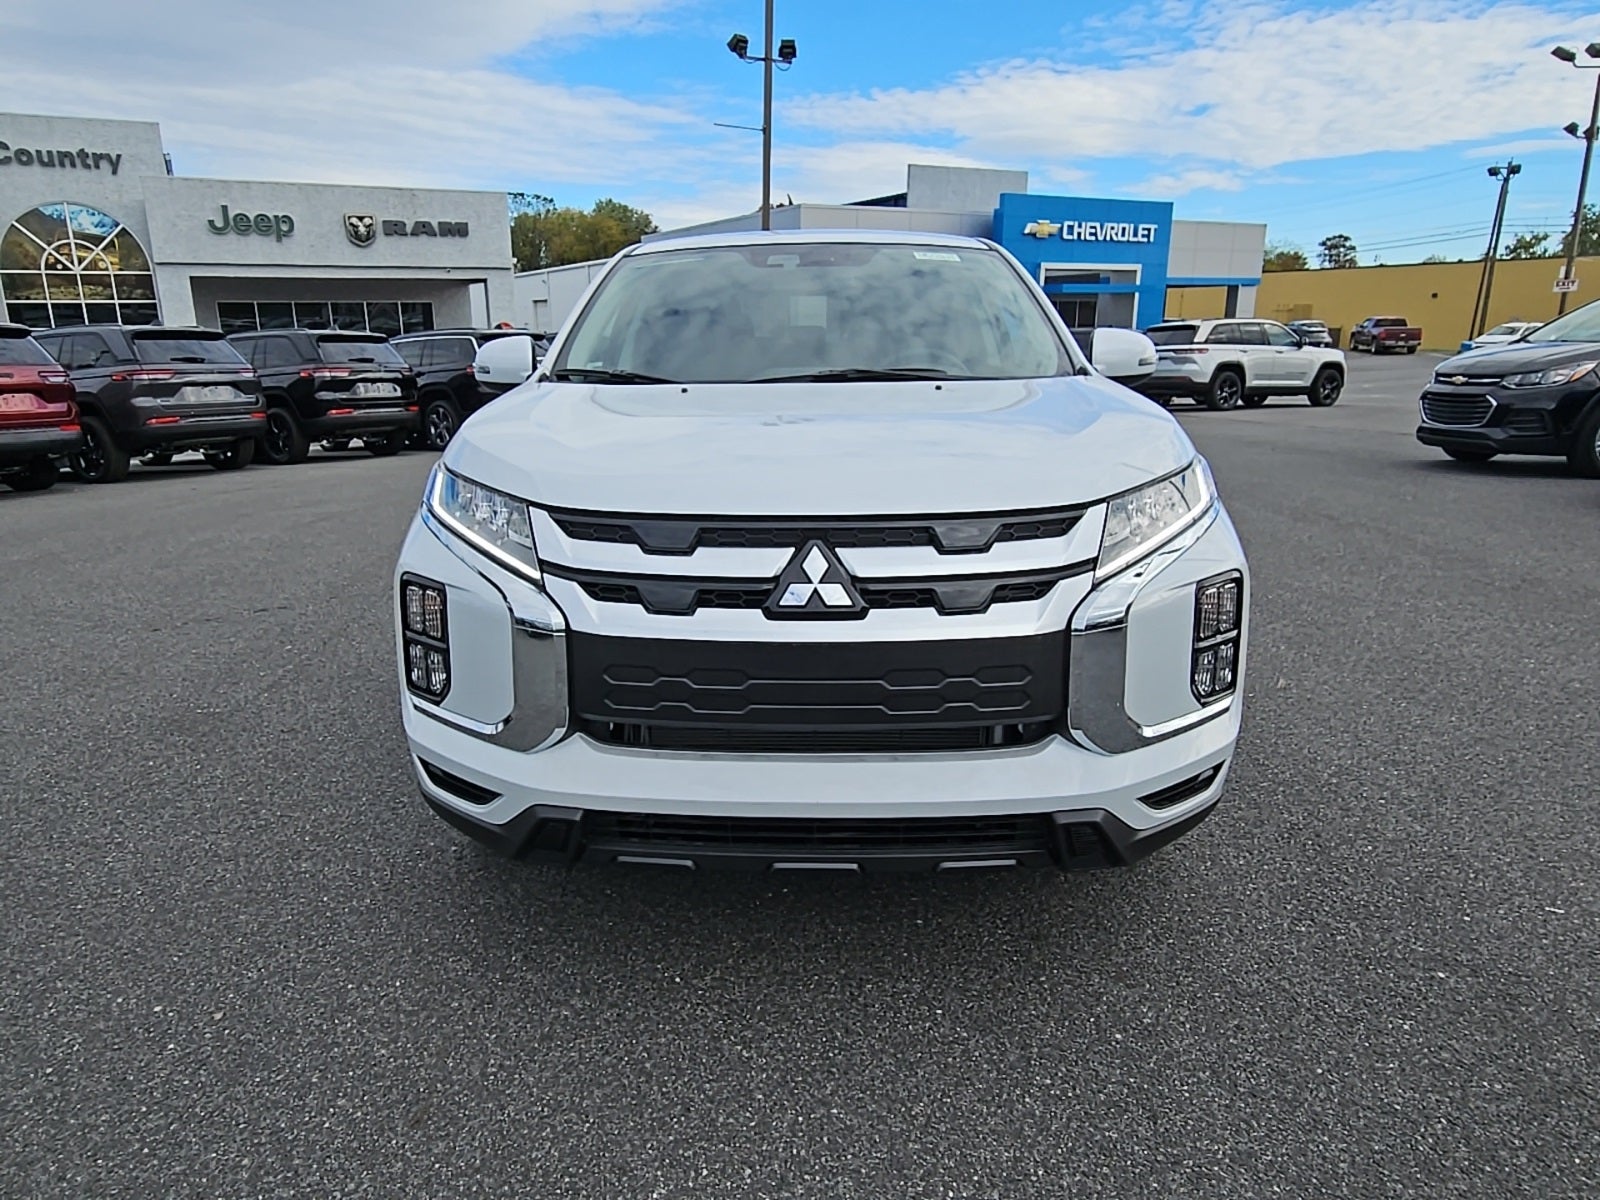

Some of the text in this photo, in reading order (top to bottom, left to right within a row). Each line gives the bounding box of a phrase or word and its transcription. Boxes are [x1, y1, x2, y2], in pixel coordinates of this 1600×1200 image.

[208, 205, 294, 242] Jeep
[382, 220, 469, 237] RAM
[1062, 221, 1158, 242] CHEVROLET
